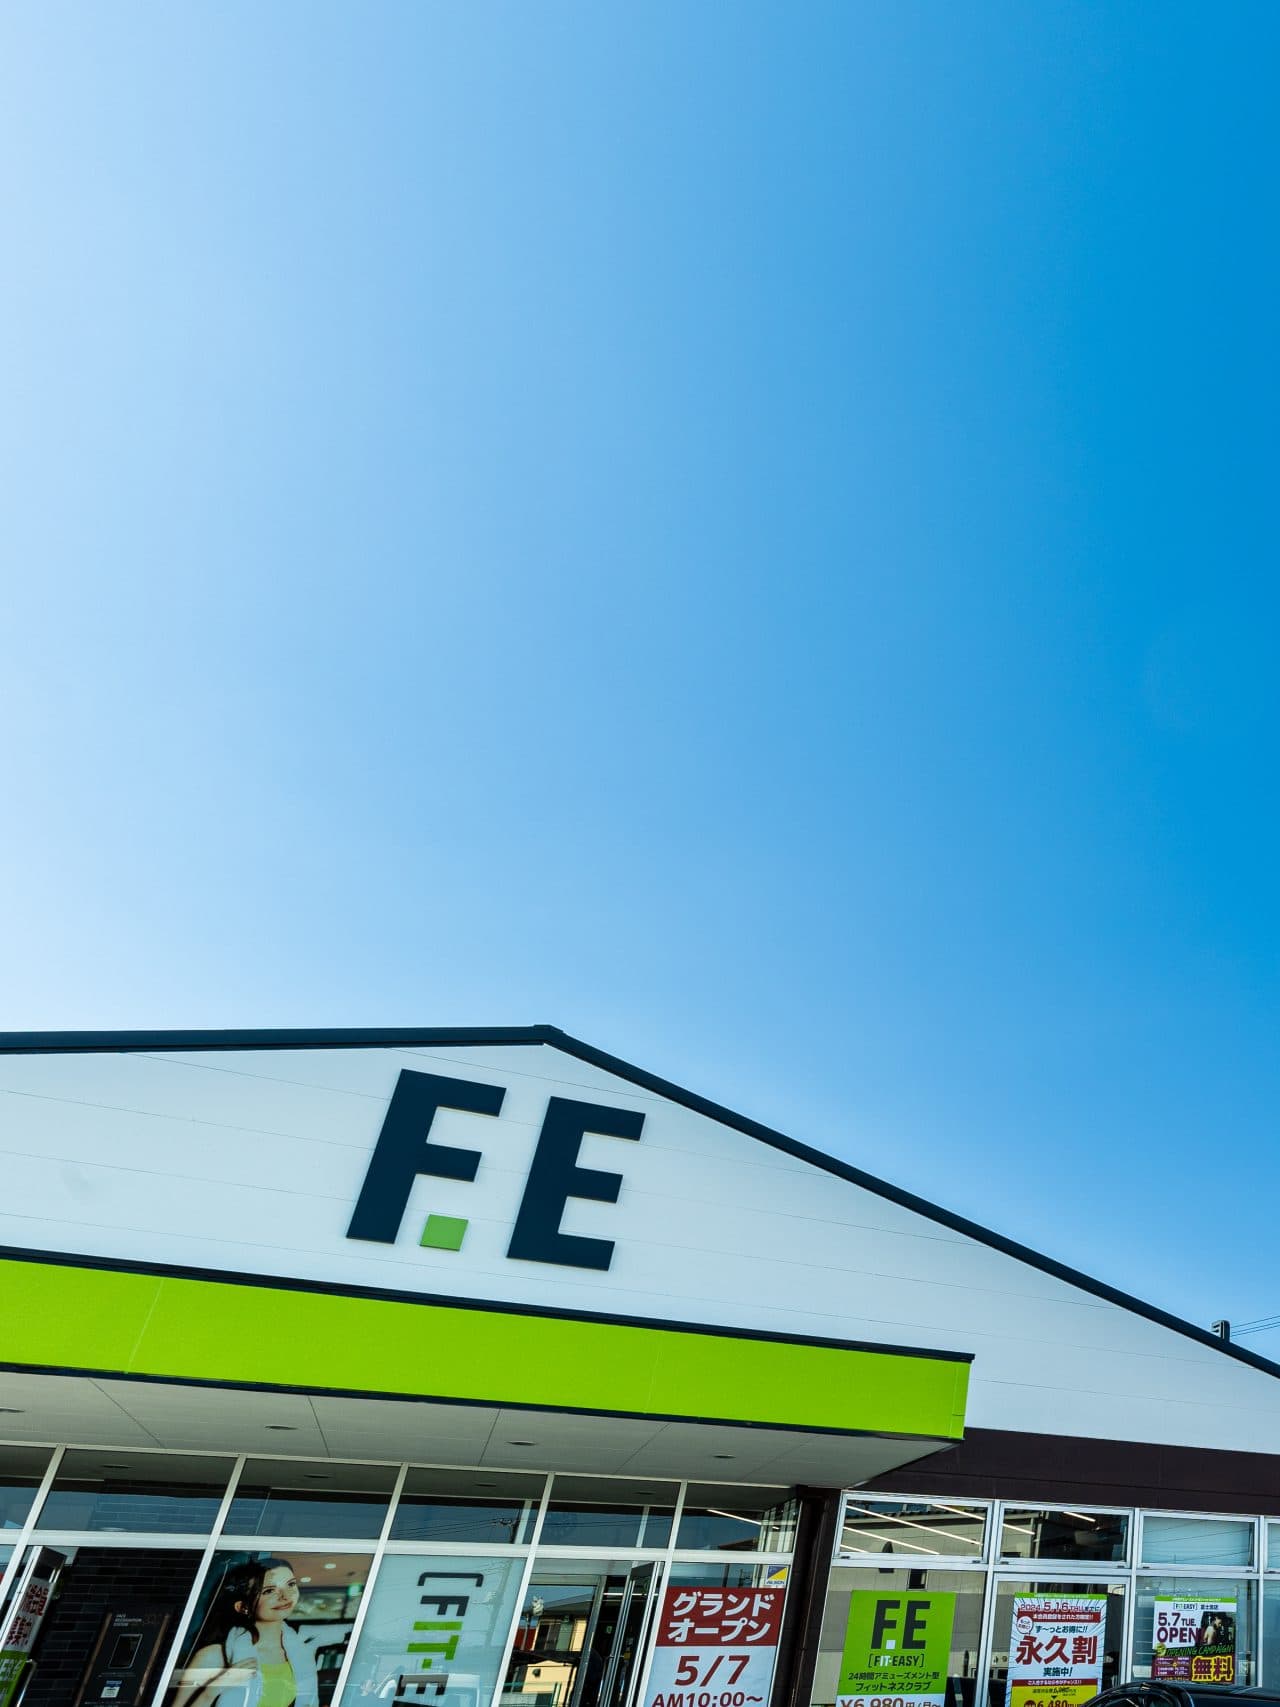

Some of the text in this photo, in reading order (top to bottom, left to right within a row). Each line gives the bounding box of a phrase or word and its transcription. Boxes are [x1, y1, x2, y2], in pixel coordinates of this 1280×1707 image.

[672, 1591, 776, 1617] グランド
[667, 1618, 771, 1643] オープン
[1158, 1612, 1181, 1626] 5.7
[1157, 1627, 1200, 1642] OPEN
[1015, 1635, 1098, 1665] 永久割
[674, 1655, 751, 1687] 5/7
[1191, 1655, 1234, 1681] 無料
[855, 1682, 932, 1692] フィットネスクラブ
